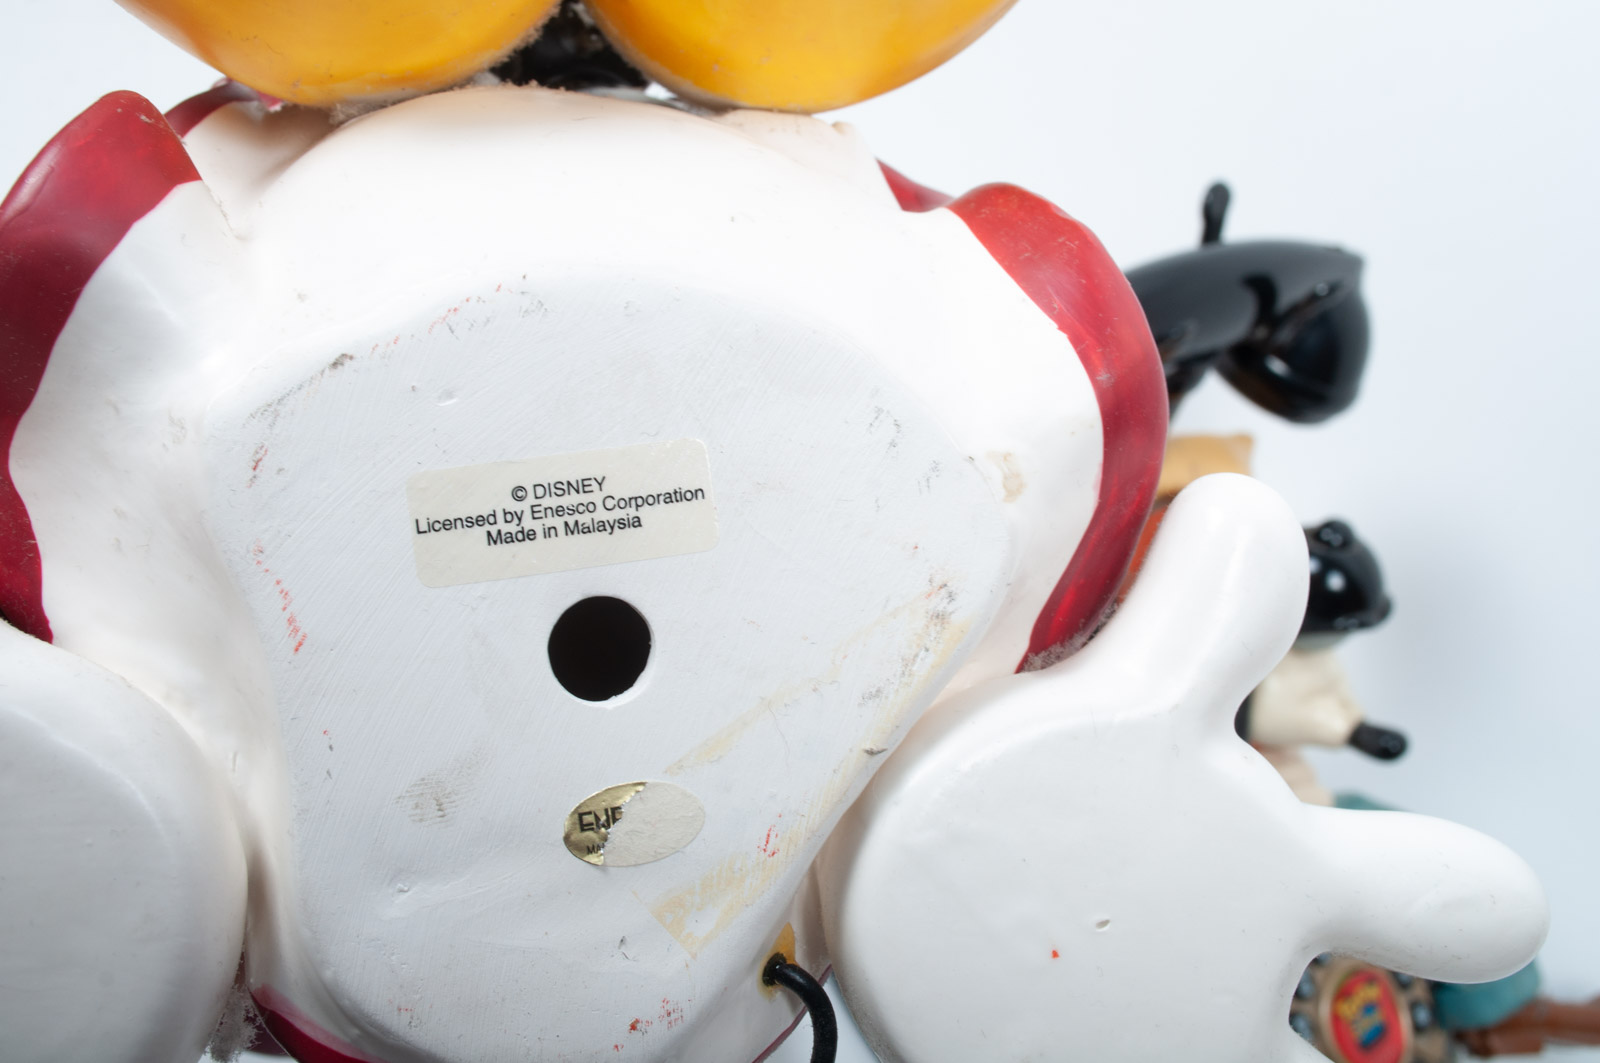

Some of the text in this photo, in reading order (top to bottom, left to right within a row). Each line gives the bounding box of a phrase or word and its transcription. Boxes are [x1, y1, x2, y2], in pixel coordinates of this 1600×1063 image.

[532, 476, 606, 500] DISNEY
[415, 487, 705, 535] Licensed by Enesco Corporation
[485, 514, 643, 546] Made in Malaysia
